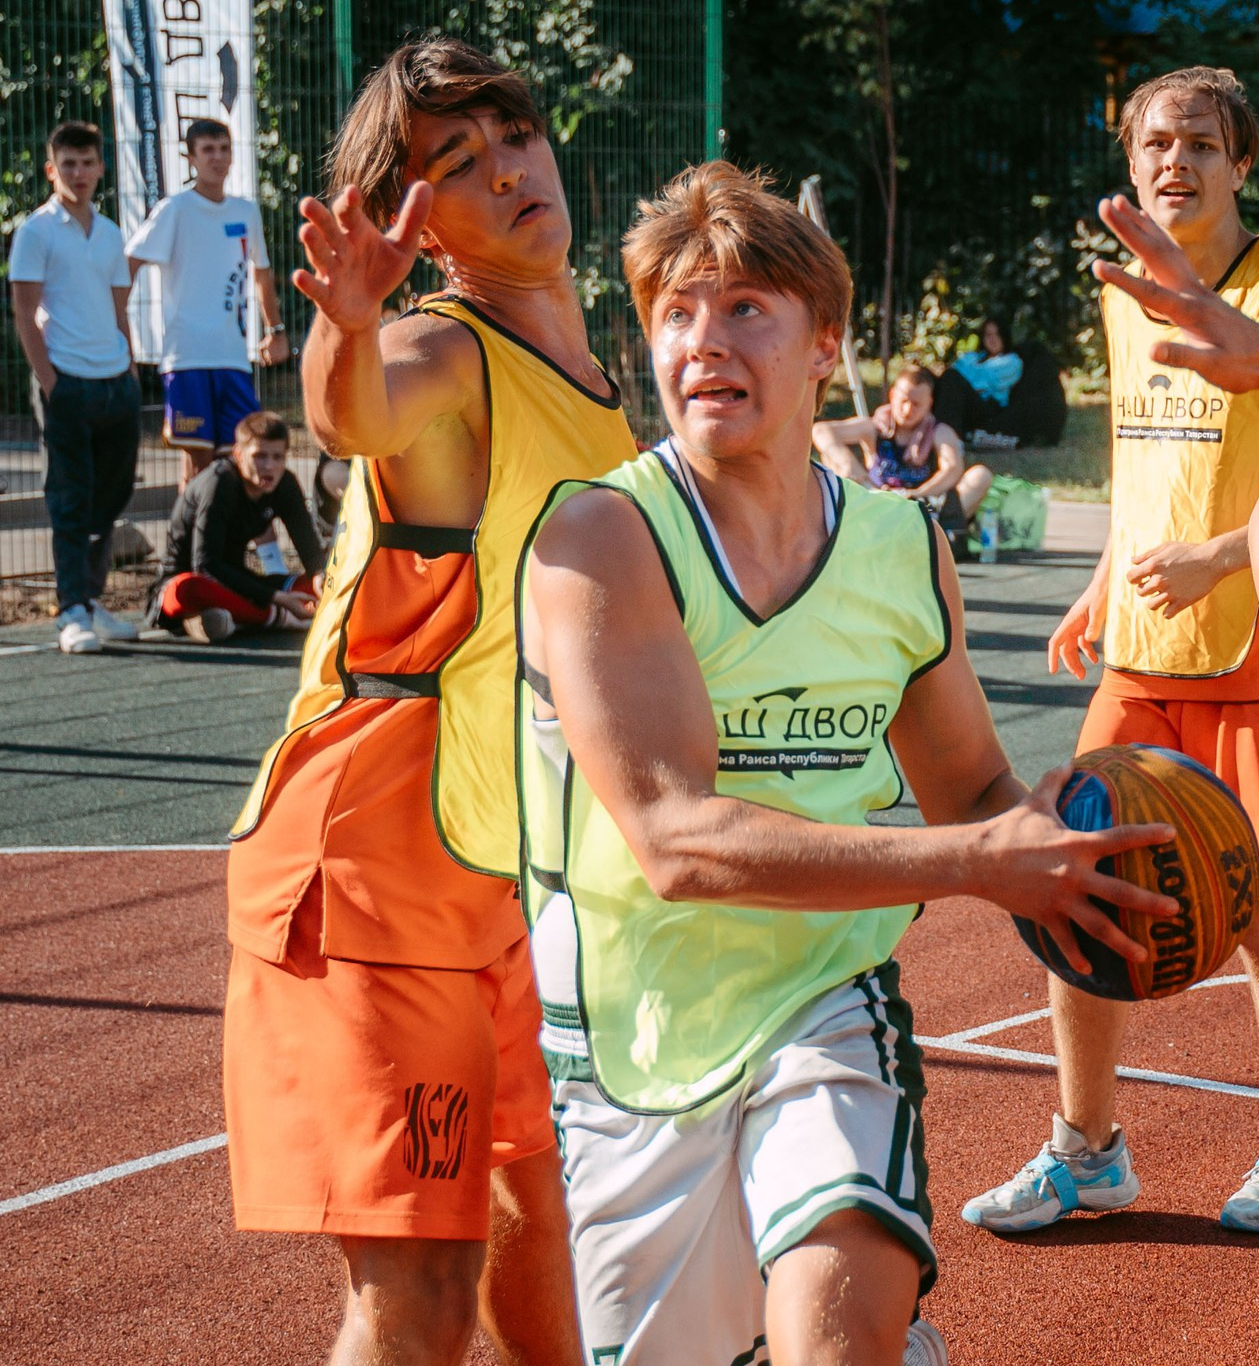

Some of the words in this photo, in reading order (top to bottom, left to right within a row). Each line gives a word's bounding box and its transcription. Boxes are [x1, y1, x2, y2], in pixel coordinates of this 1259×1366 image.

[1161, 397, 1224, 420] ДВОР
[783, 704, 888, 742] ДВОР
[738, 753, 776, 765] Раиса
[778, 751, 839, 766] Республики
